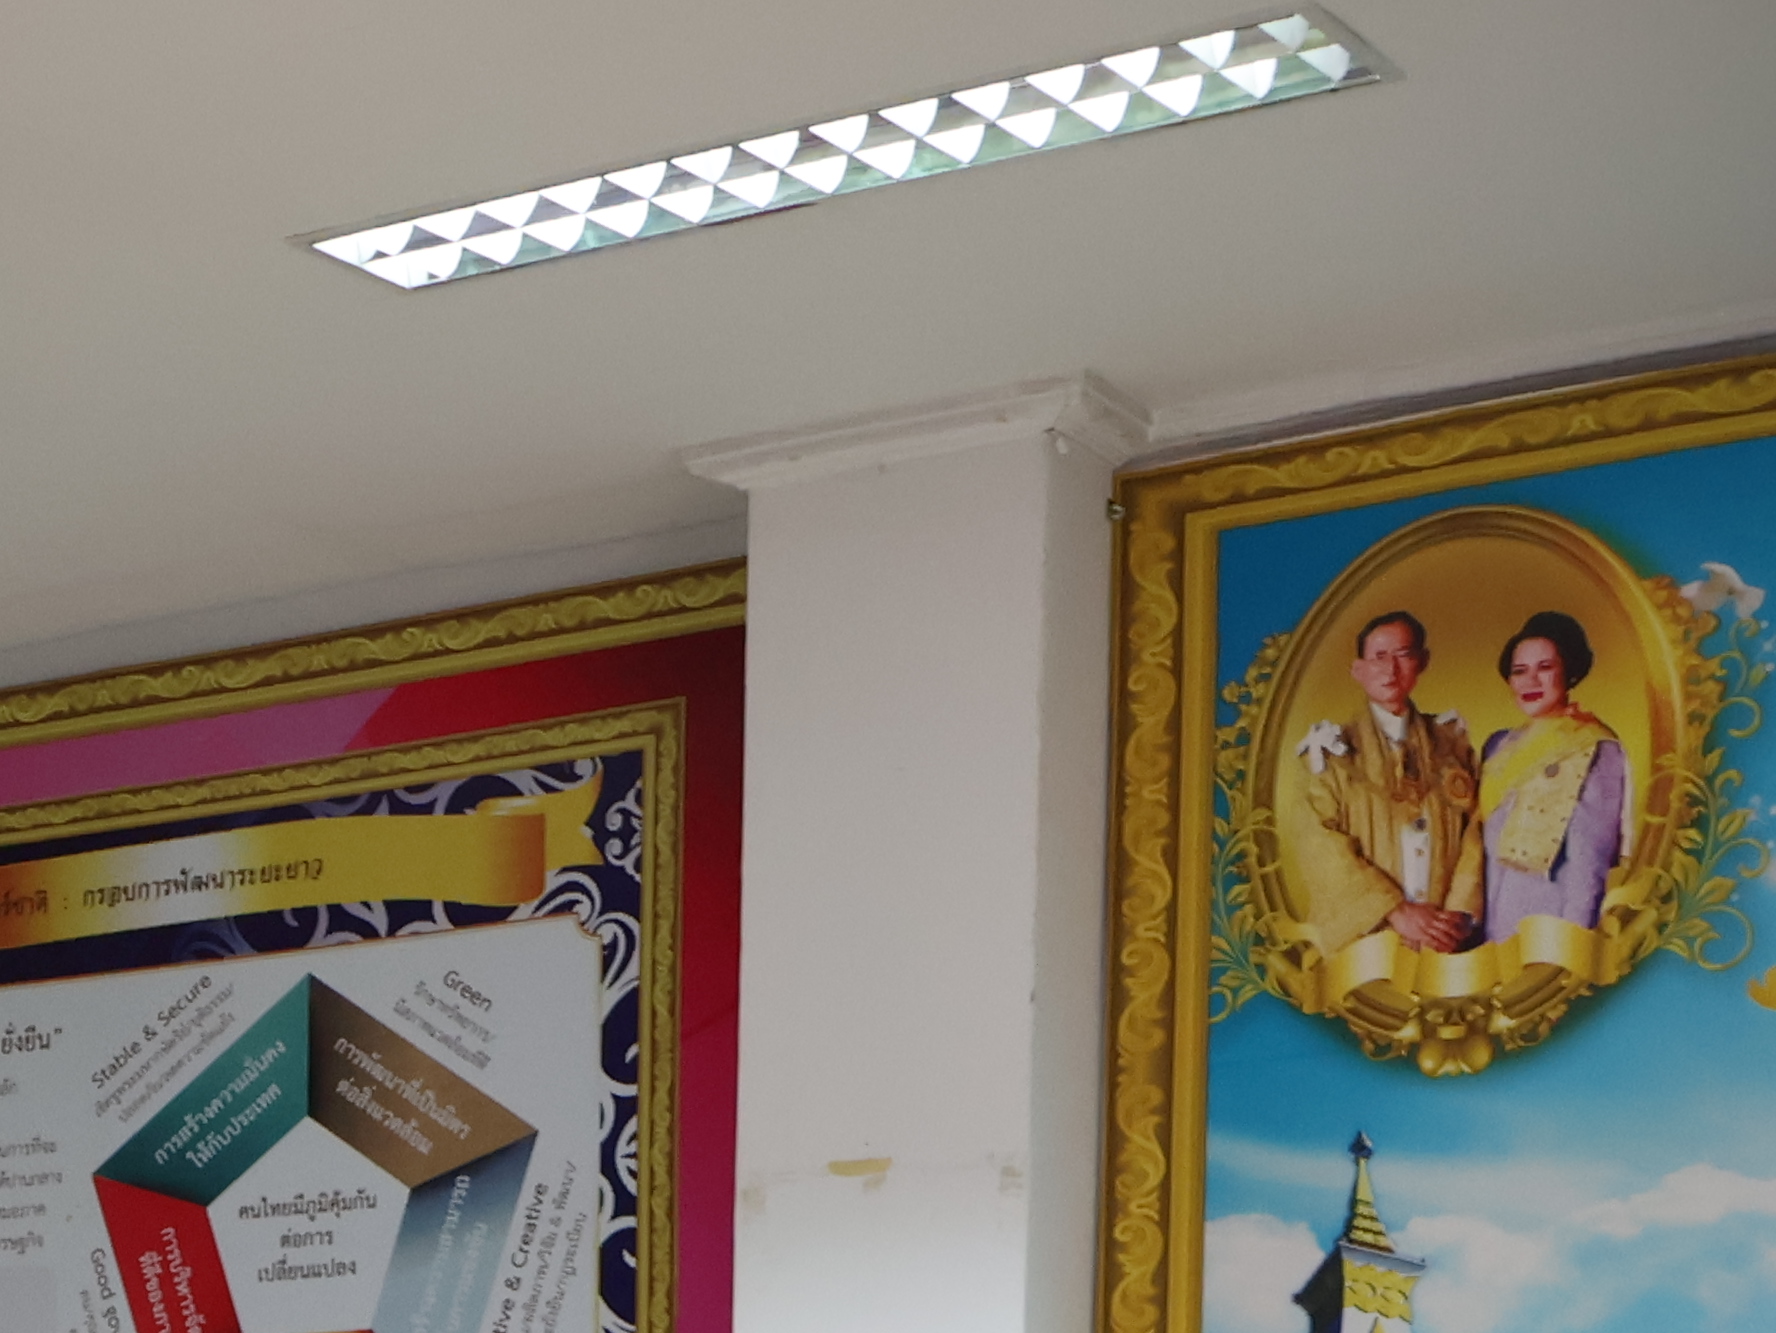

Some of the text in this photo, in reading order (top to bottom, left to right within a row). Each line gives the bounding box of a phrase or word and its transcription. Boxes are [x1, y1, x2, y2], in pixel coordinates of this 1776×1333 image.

[442, 969, 494, 1012] Green
[91, 1039, 143, 1090] Stable
[157, 974, 213, 1029] Secure
[279, 1226, 334, 1248] ต่อการ
[512, 1182, 549, 1270] Creative
[91, 1248, 115, 1306] Good
